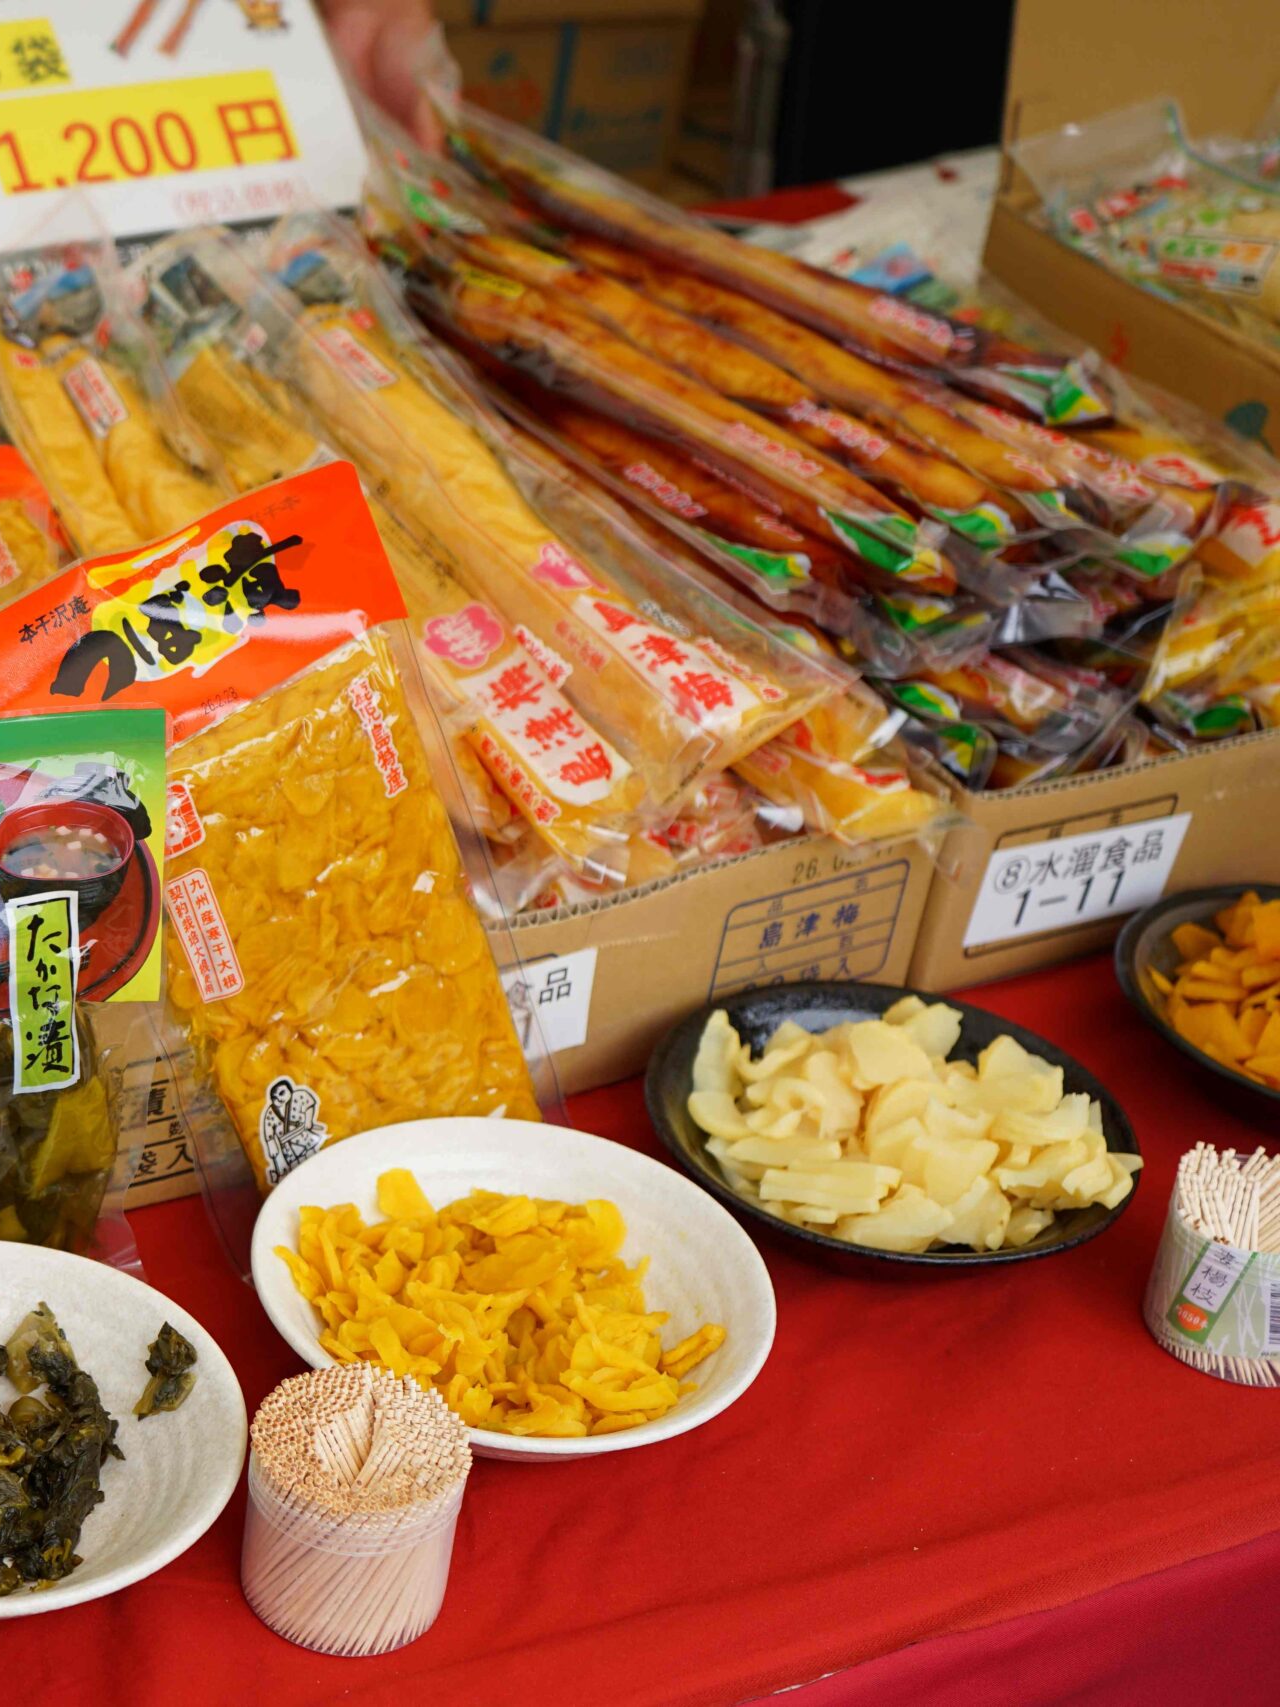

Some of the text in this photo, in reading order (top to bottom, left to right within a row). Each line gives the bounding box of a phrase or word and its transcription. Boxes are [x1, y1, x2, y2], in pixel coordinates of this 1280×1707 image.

[18, 595, 91, 644] 本干沢庵
[50, 532, 303, 702] つぼ漬
